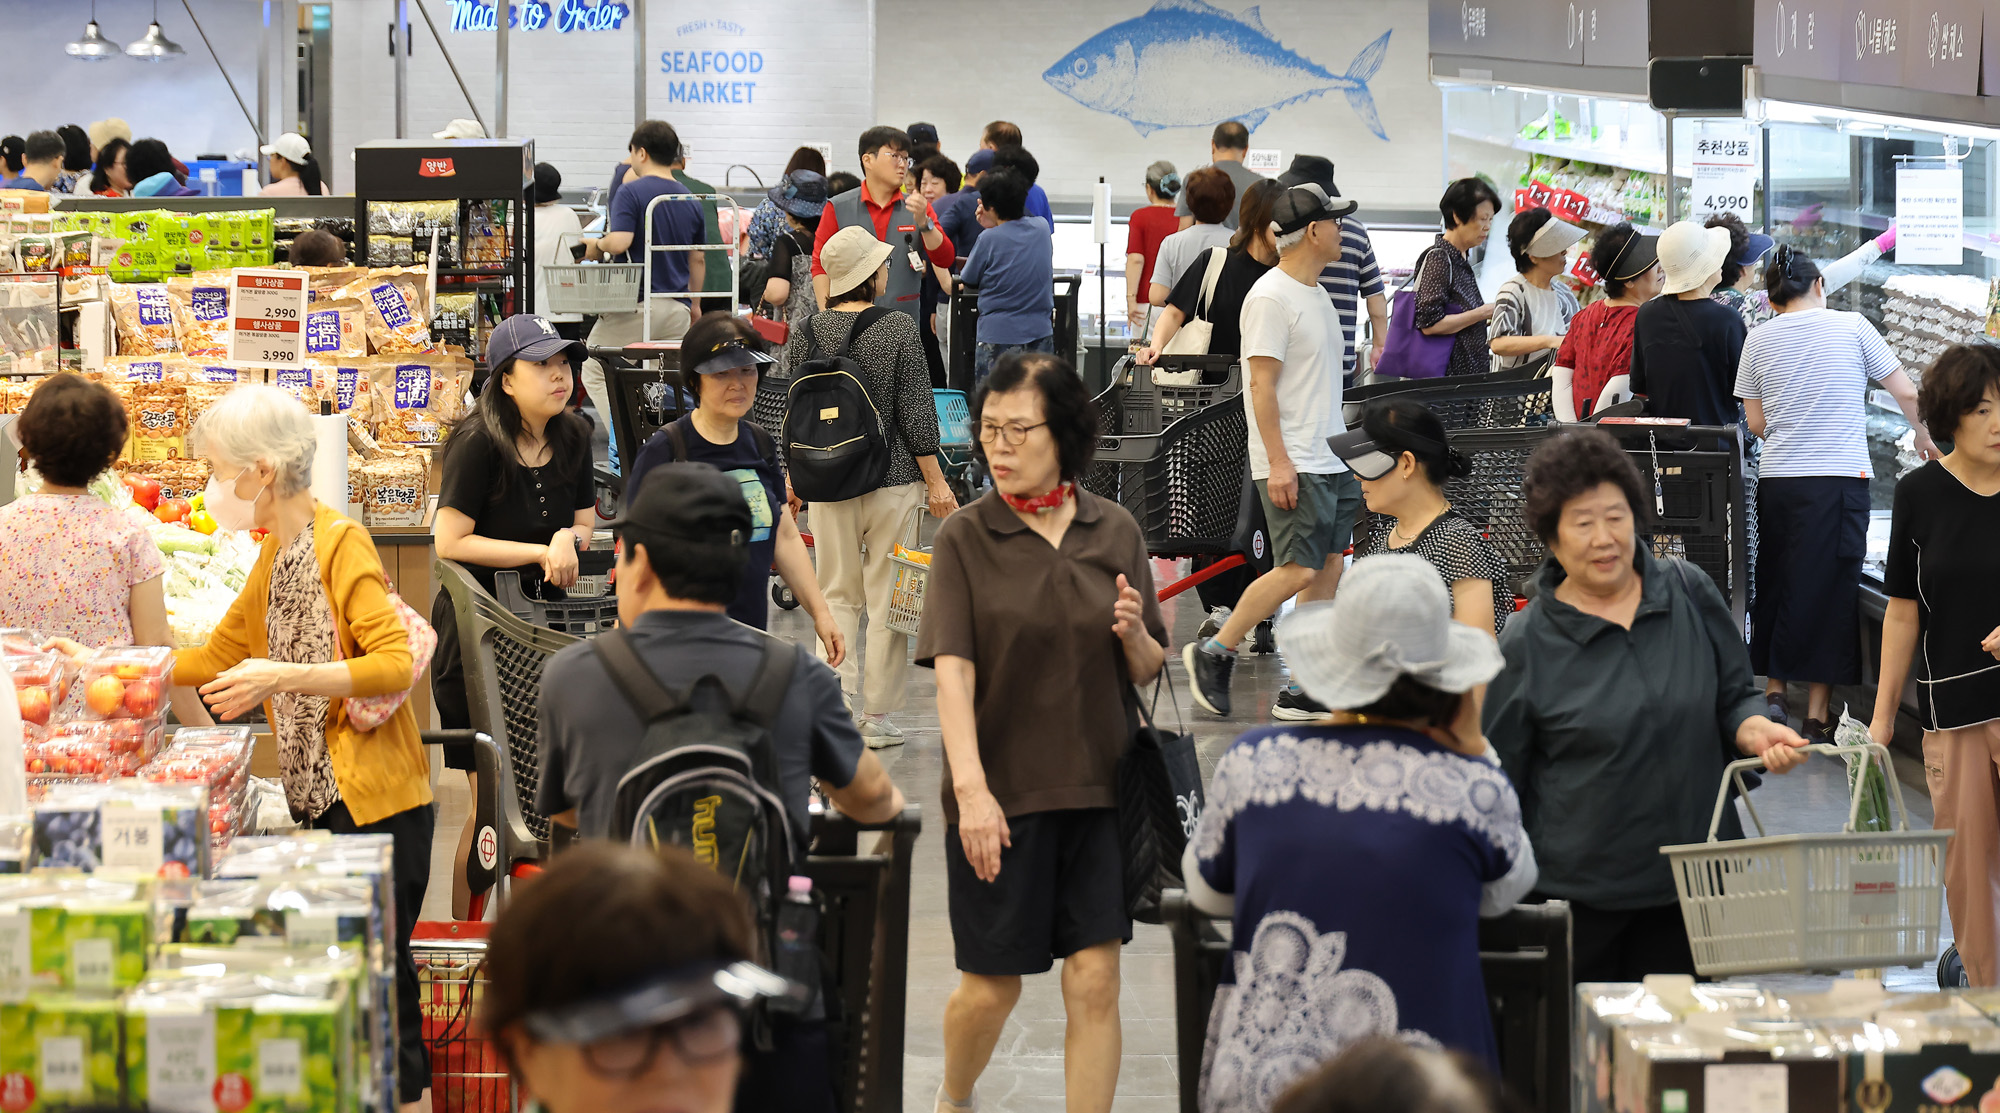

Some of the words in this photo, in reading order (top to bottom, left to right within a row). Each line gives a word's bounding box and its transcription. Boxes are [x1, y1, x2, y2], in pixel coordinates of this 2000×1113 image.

[446, 0, 510, 34] Mad
[520, 0, 545, 31] to
[554, 0, 623, 33] Order
[676, 18, 707, 37] FRESH
[716, 18, 745, 37] TASTY
[1869, 17, 1897, 55] 나물/해초
[1941, 22, 1964, 61] 쌈채소
[661, 51, 763, 73] SEAFOOD
[669, 81, 756, 104] MARKET
[1697, 139, 1749, 156] 추천상품
[426, 160, 447, 173] 양반
[1529, 184, 1551, 205] 1+1
[1704, 195, 1748, 211] 4,990
[1563, 194, 1585, 215] 1+1
[255, 277, 284, 288] 행사상품
[265, 307, 296, 318] 2,990
[252, 320, 282, 331] 행사상품
[262, 350, 294, 361] 3,990
[377, 487, 416, 504] 볶음땅콩
